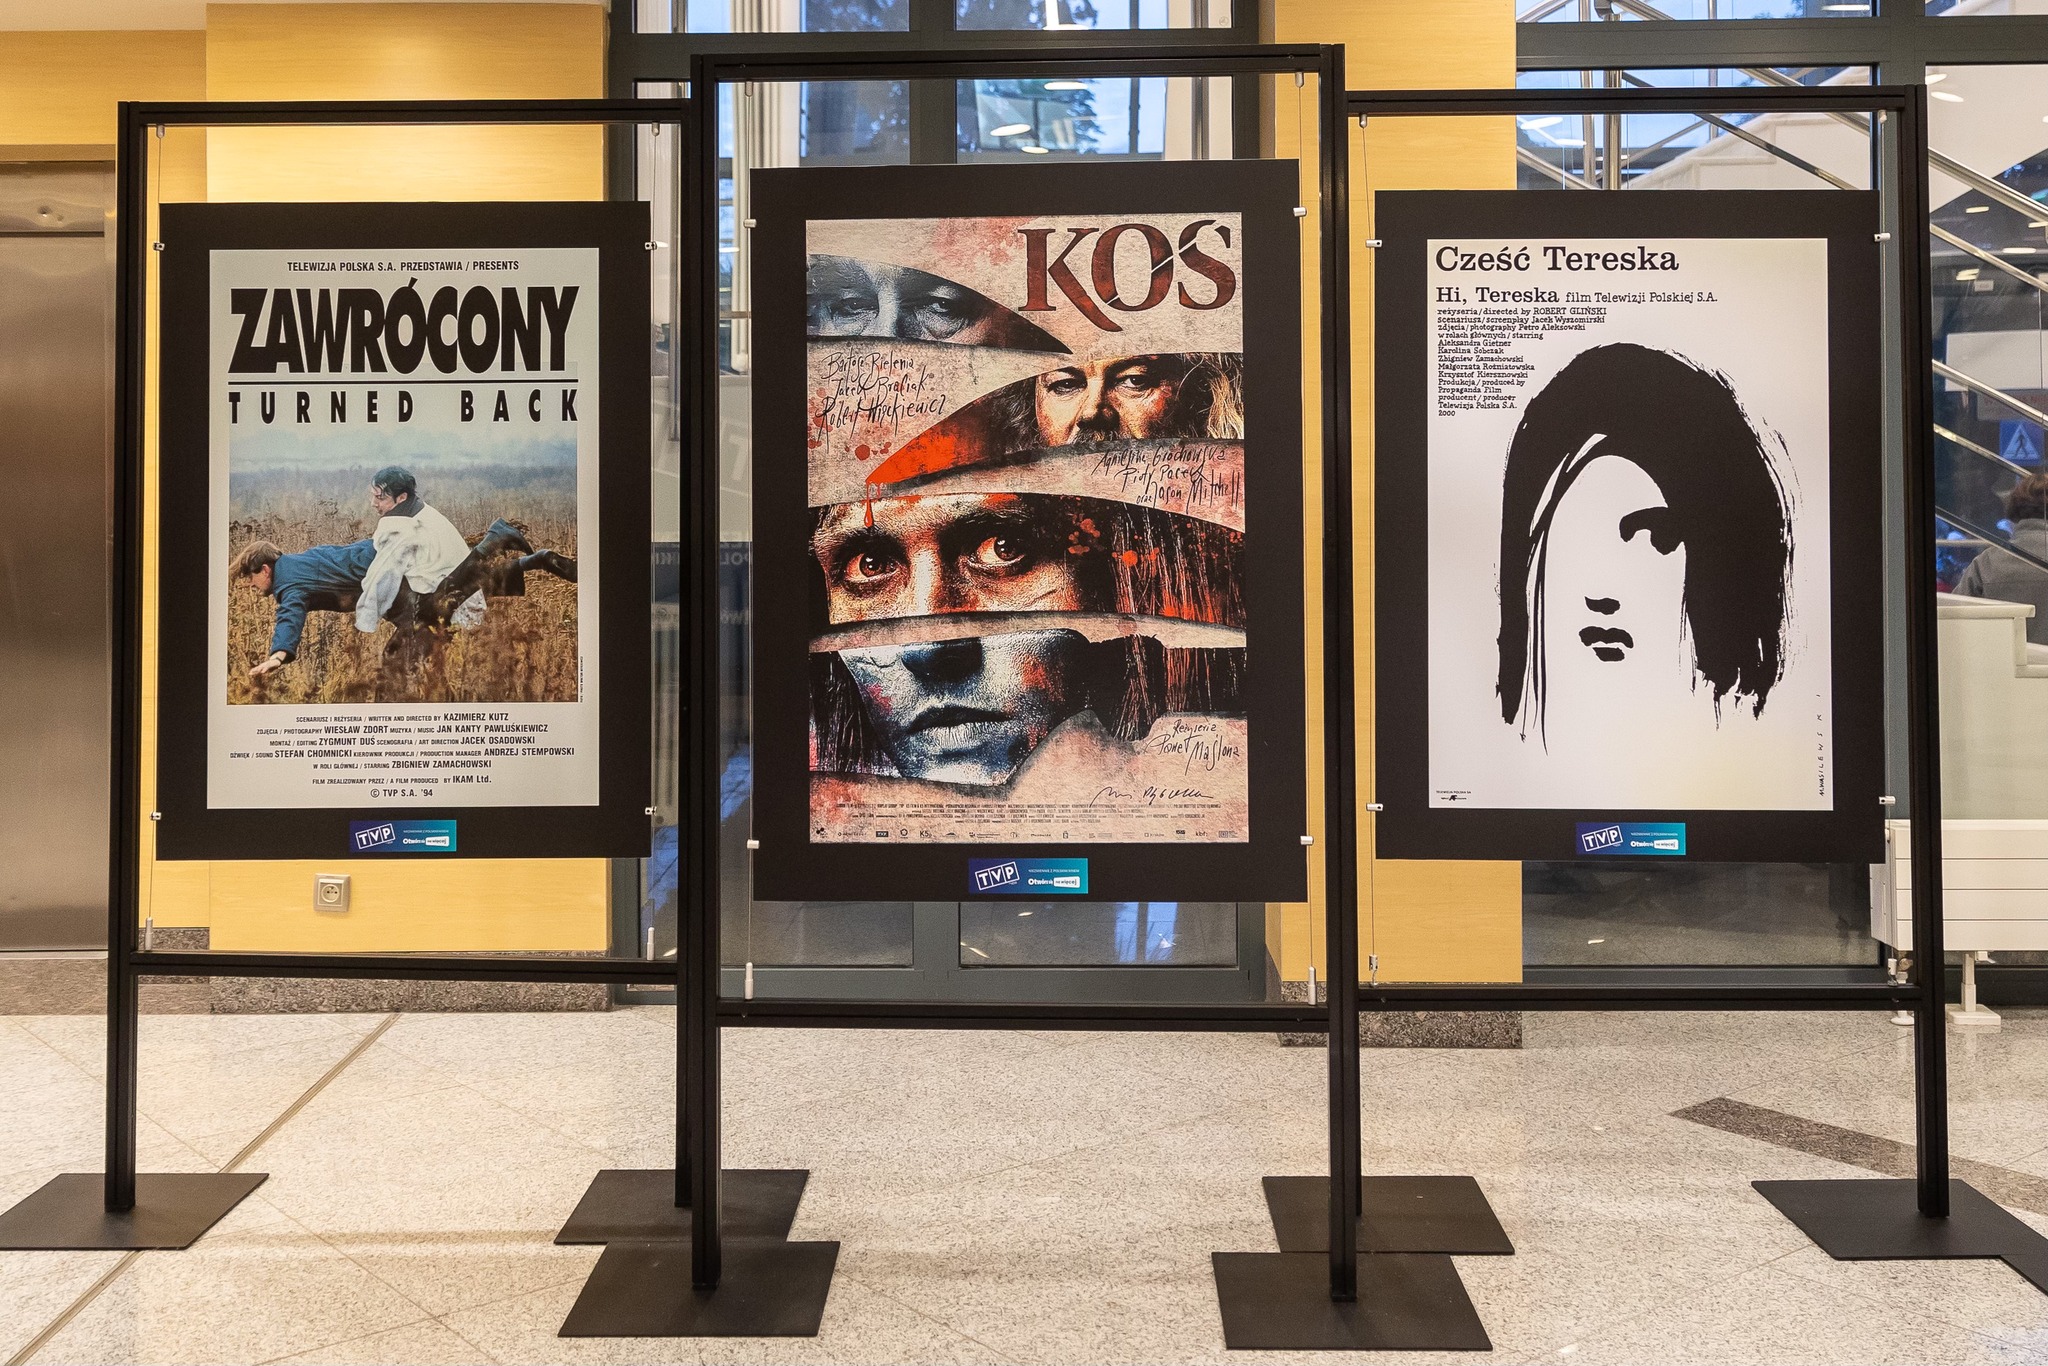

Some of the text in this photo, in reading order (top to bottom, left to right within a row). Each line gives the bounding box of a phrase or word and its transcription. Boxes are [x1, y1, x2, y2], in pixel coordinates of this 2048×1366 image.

[1436, 246, 1680, 272] Cześć Tereska
[287, 262, 336, 272] TELEWIZJA
[340, 262, 375, 272] POLSKA
[378, 262, 396, 272] S.A.
[400, 261, 462, 272] PRZEDSTAWIA
[473, 261, 519, 271] PRESENTS
[1017, 219, 1236, 332] KOS
[1436, 287, 1718, 306] Hi, Tereska film Telewizji Polskiej S.A.
[1521, 308, 1531, 316] by
[1533, 307, 1567, 315] ROBERT
[1569, 306, 1607, 315] GLIŃSKI
[1532, 316, 1554, 324] Jacek
[1554, 316, 1605, 324] Wyszomirski
[228, 277, 580, 374] ZAWRÓCONY
[1470, 332, 1506, 340] głównych
[1512, 332, 1544, 340] starring
[1438, 355, 1524, 363] Zbigniew Zamachowski
[1438, 363, 1481, 371] Małgorzata
[1438, 386, 1502, 394] Propaganda Film
[228, 389, 578, 424] TURNED BACK
[1438, 402, 1474, 410] Telewizja
[444, 713, 486, 721] KAZIMIERZ
[489, 713, 509, 721] KUTZ
[324, 726, 360, 734] WIESŁAW
[363, 726, 388, 734] ZDORT
[437, 725, 452, 733] JAN
[455, 725, 481, 733] KANTY
[484, 723, 548, 733] PAWLUŚKIEWICZ
[319, 738, 357, 746] ZYGMUNT
[360, 735, 376, 746] DUŚ
[460, 737, 486, 745] JACEK
[489, 736, 535, 744] OSADOWSKI
[274, 750, 304, 758] STEFAN
[307, 749, 352, 758] CHOMNICKI
[484, 748, 518, 756] ANDRZEJ
[522, 748, 574, 756] STEMPOWSKI
[392, 761, 430, 769] ZBIGNIEW
[433, 760, 492, 768] ZAMACHOWSKI
[453, 776, 474, 784] IKAM
[477, 775, 492, 783] Ltd.
[382, 789, 398, 798] TVP
[401, 788, 418, 798] S.A.
[420, 788, 433, 798] '94
[357, 826, 392, 847] TVP
[1583, 828, 1620, 850] TVP
[977, 864, 1017, 888] TVP
